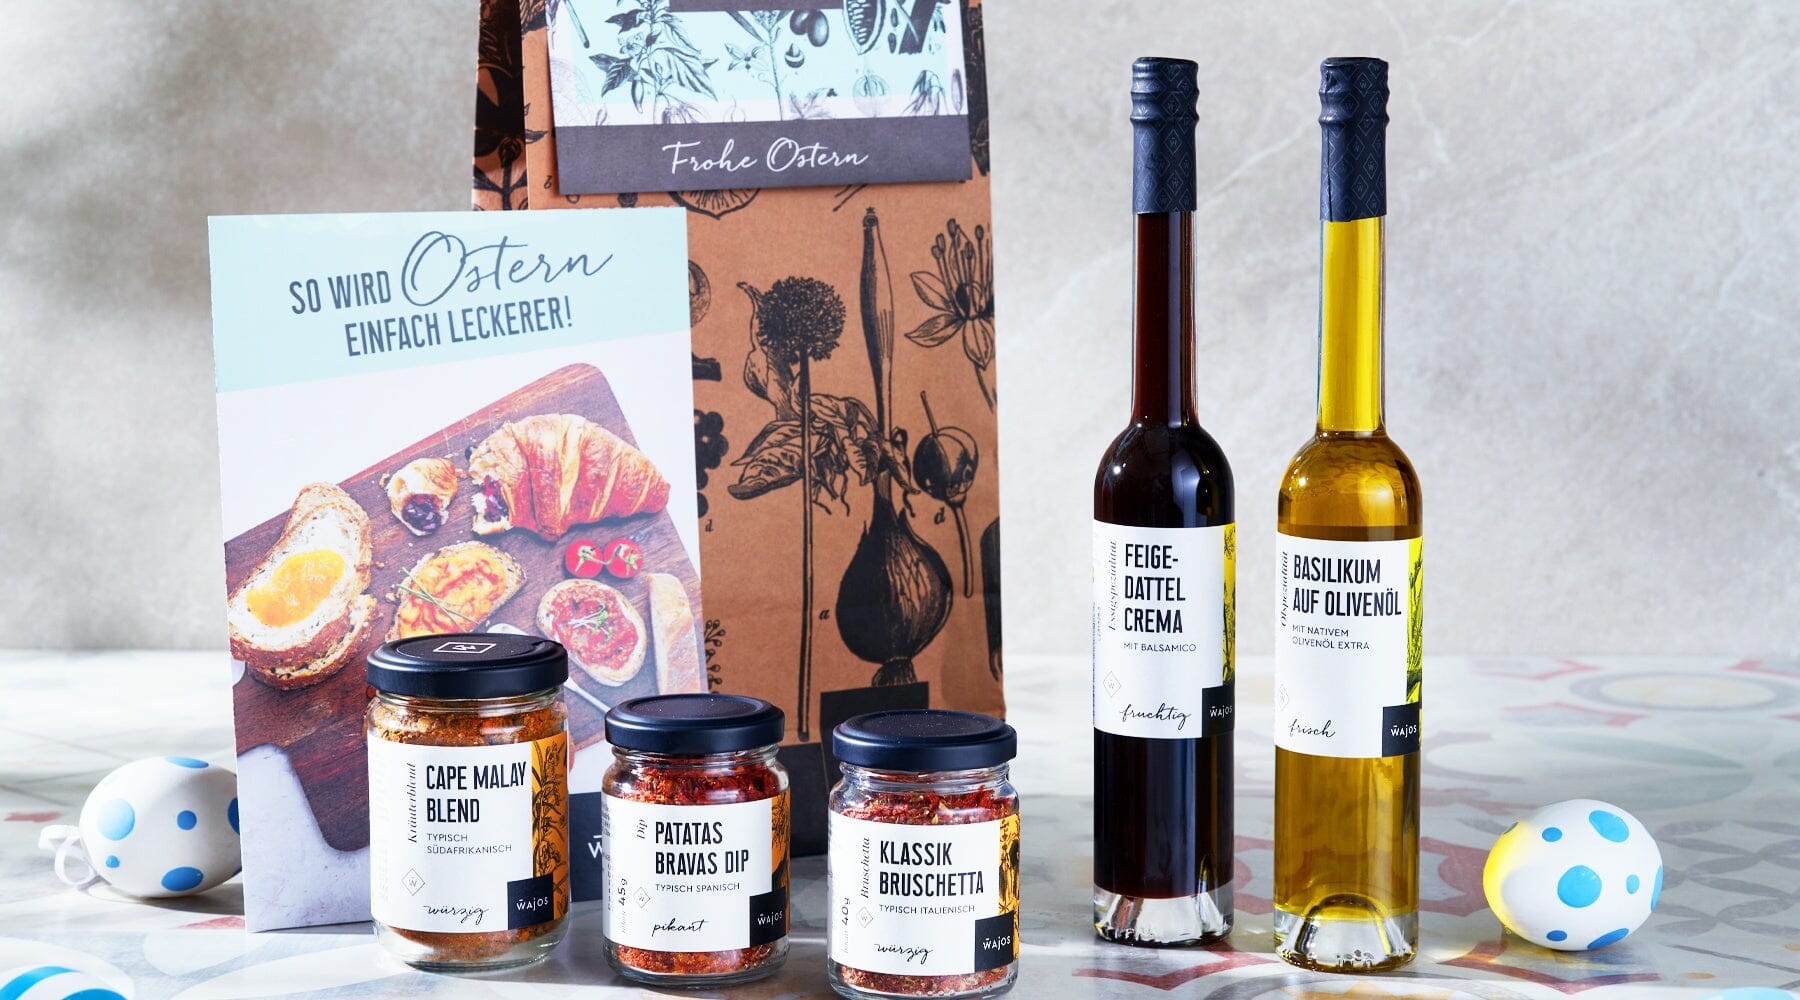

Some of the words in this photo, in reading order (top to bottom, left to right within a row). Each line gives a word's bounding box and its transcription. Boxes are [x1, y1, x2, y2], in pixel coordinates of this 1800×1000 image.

[662, 138, 757, 174] Frohe
[766, 137, 869, 172] Ostern
[289, 278, 322, 315] SO
[327, 270, 392, 310] WIRD
[401, 231, 614, 307] Ostern
[344, 312, 442, 357] EINFACH
[447, 295, 574, 343] LECKERER!
[1124, 543, 1179, 569] FEIGE-
[1293, 554, 1381, 584] BASILIKUM
[1124, 575, 1186, 601] DATTEL
[1292, 587, 1320, 614] AUF
[1324, 587, 1402, 617] OLIVENÖL
[1124, 607, 1184, 634] CREMA
[1292, 624, 1306, 634] MIT
[1307, 625, 1350, 637] NATIVEM
[1123, 642, 1140, 651] MIT
[1140, 643, 1197, 652] BALSAMICO
[1292, 636, 1335, 649] OLIVENÖL
[1337, 640, 1370, 650] EXTRA
[1119, 702, 1192, 731] fruchtig
[1287, 718, 1336, 738] frisch
[425, 764, 468, 790] CAPE
[473, 761, 527, 790] MALAY
[407, 762, 418, 844] Kräuterblend
[426, 797, 480, 823] BLEND
[426, 832, 468, 843] TYPISCH
[636, 819, 648, 840] Dip
[655, 821, 723, 845] PATATAS
[426, 843, 513, 856] SÜDAFRIKANISCH
[655, 851, 718, 876] BRAVAS
[725, 849, 750, 874] DIP
[880, 840, 953, 866] KLASSIK
[860, 836, 871, 899] Bruschetta
[655, 883, 693, 893] TYPISCH
[696, 882, 740, 893] SPANISCH
[879, 870, 985, 897] BRUSCHETTA
[423, 904, 490, 924] würzig
[879, 904, 917, 915] TYPISCH
[920, 904, 975, 915] ITALIENISCH
[651, 917, 710, 937] pikant
[873, 943, 934, 965] würzig
